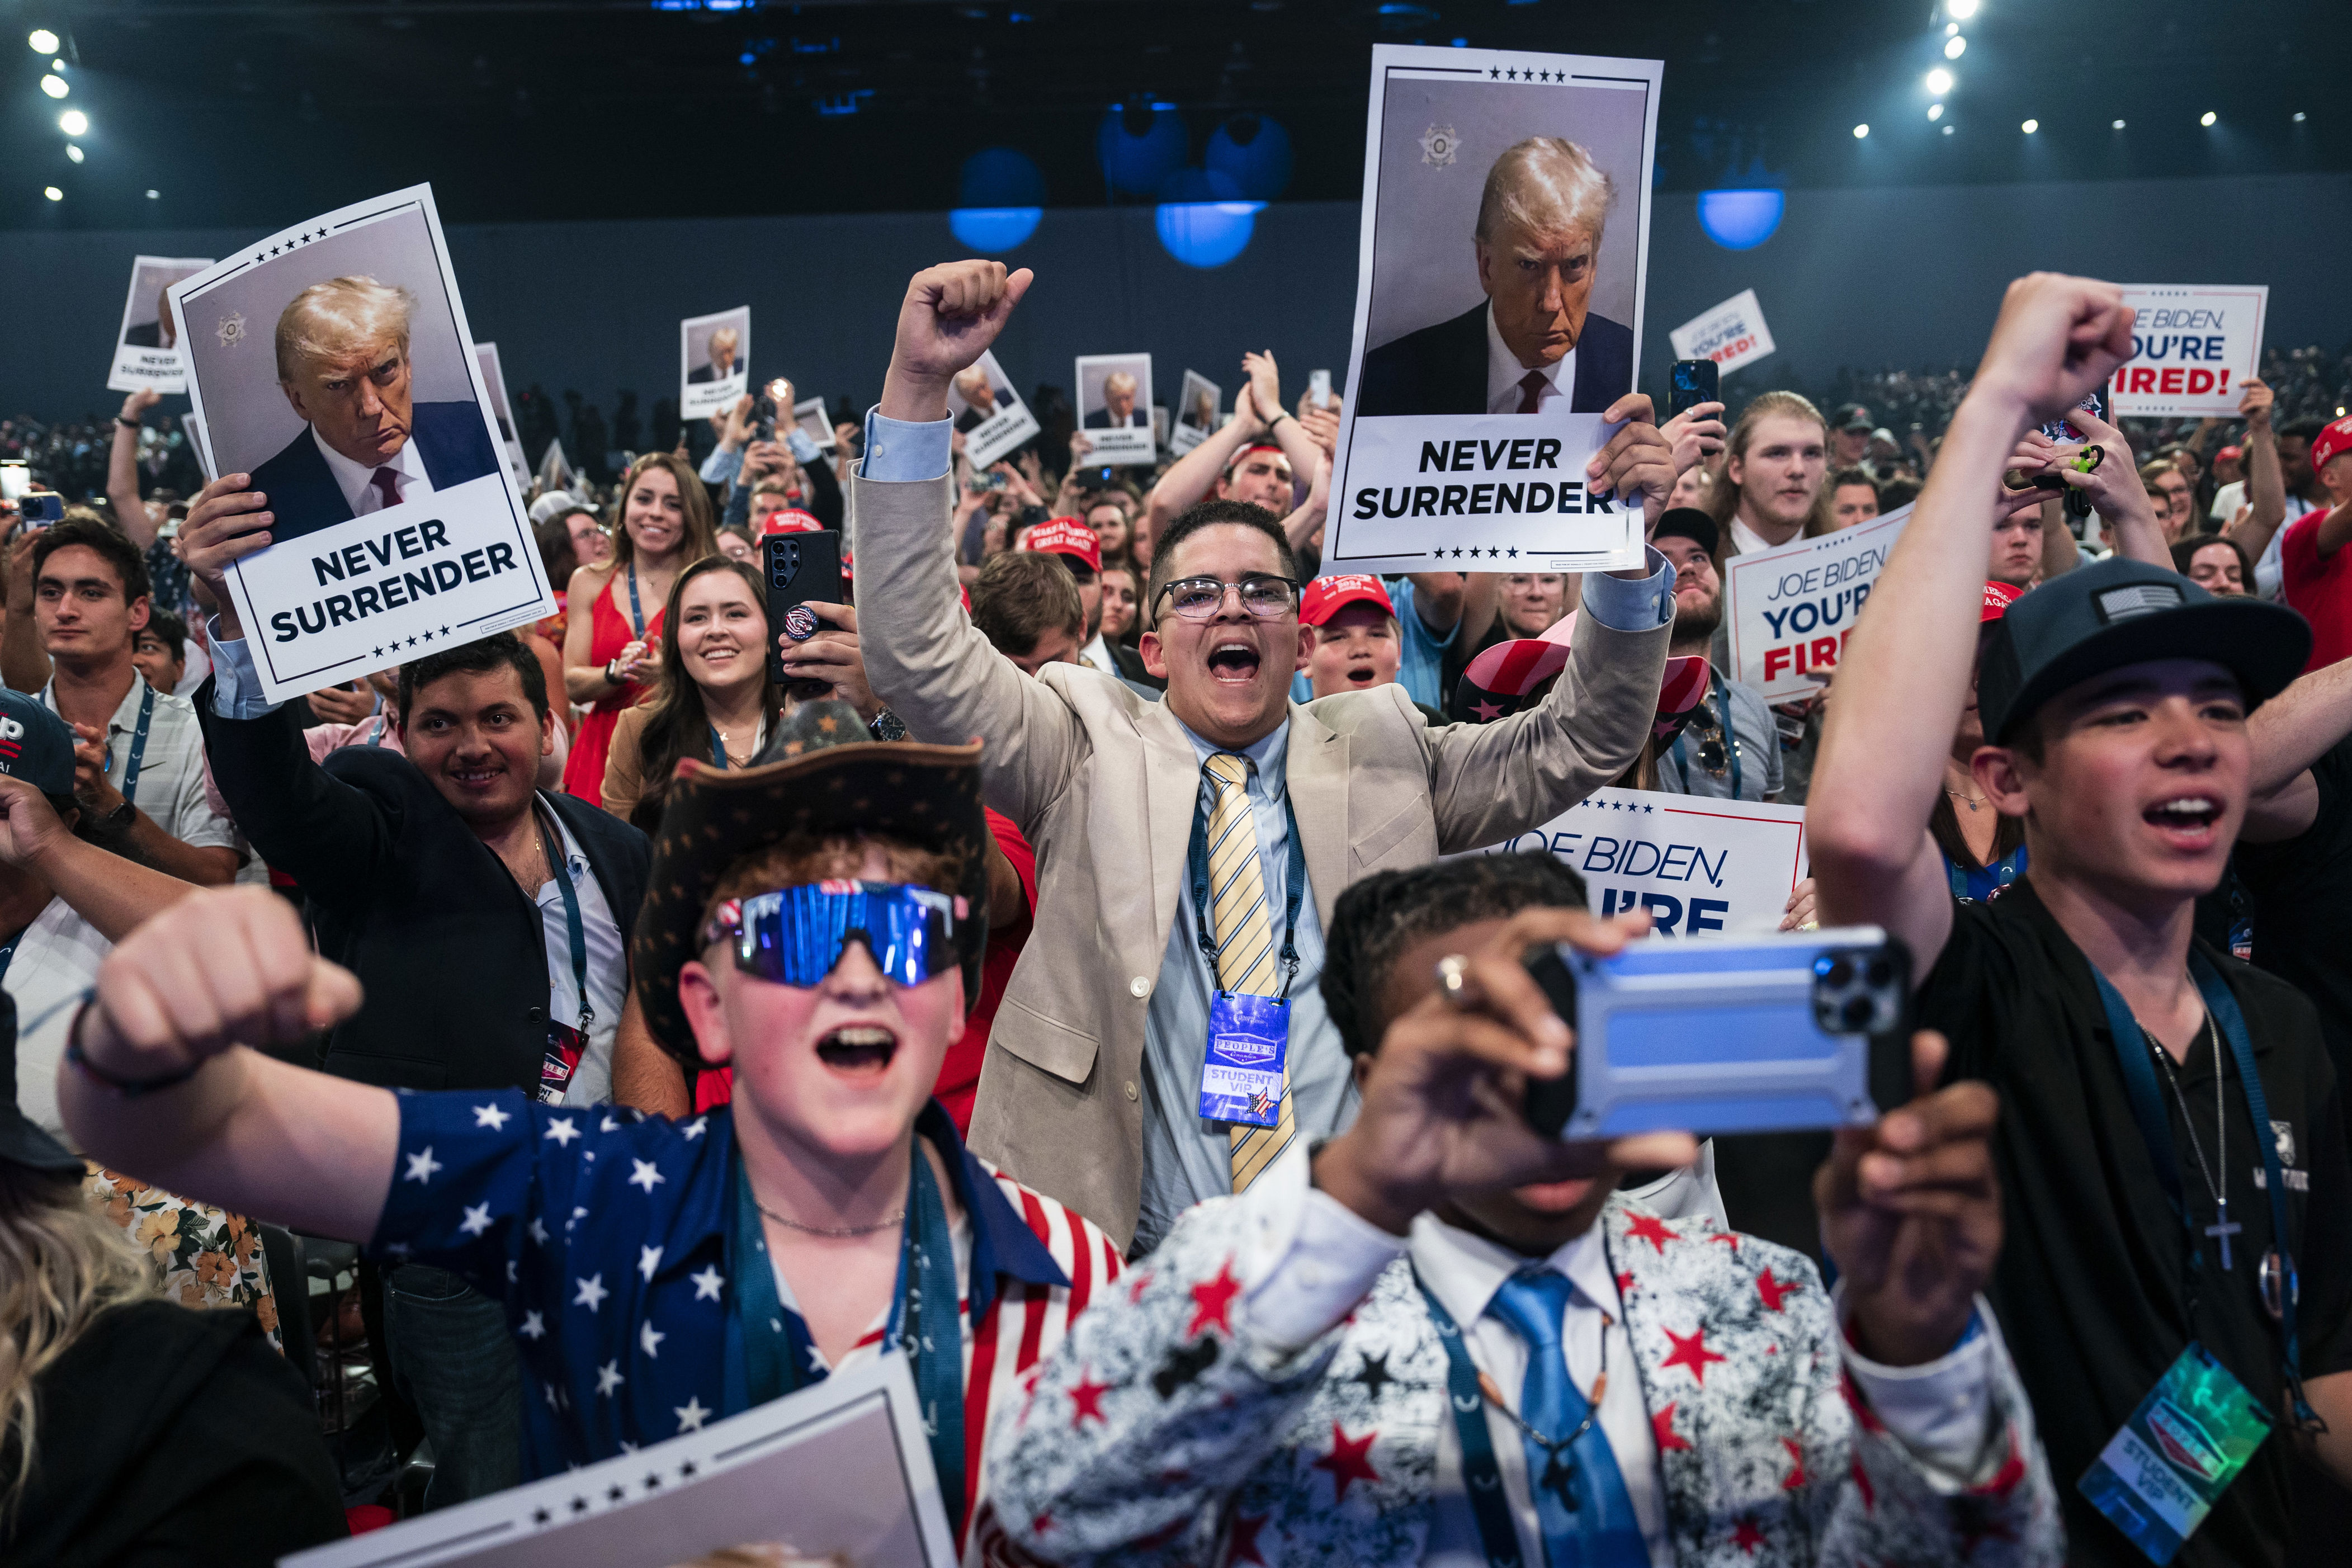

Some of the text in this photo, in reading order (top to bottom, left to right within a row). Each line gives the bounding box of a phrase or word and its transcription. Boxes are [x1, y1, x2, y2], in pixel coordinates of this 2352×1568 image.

[2124, 334, 2225, 361] OU'RE
[2108, 367, 2230, 395] IRED!
[1419, 438, 1561, 473] NEVER
[1353, 481, 1614, 519] SURRENDER
[311, 519, 451, 587] NEVER
[271, 542, 518, 643] SURRENDER
[1768, 568, 1820, 601] JOE
[1763, 577, 1879, 640] YOU'R
[1583, 836, 1728, 888] BIDEN,
[1216, 1040, 1275, 1054] PEOPLE'S
[1211, 1069, 1273, 1085] STUDENT
[1230, 1083, 1252, 1092] VIP
[2123, 1439, 2198, 1509] STUDENT
